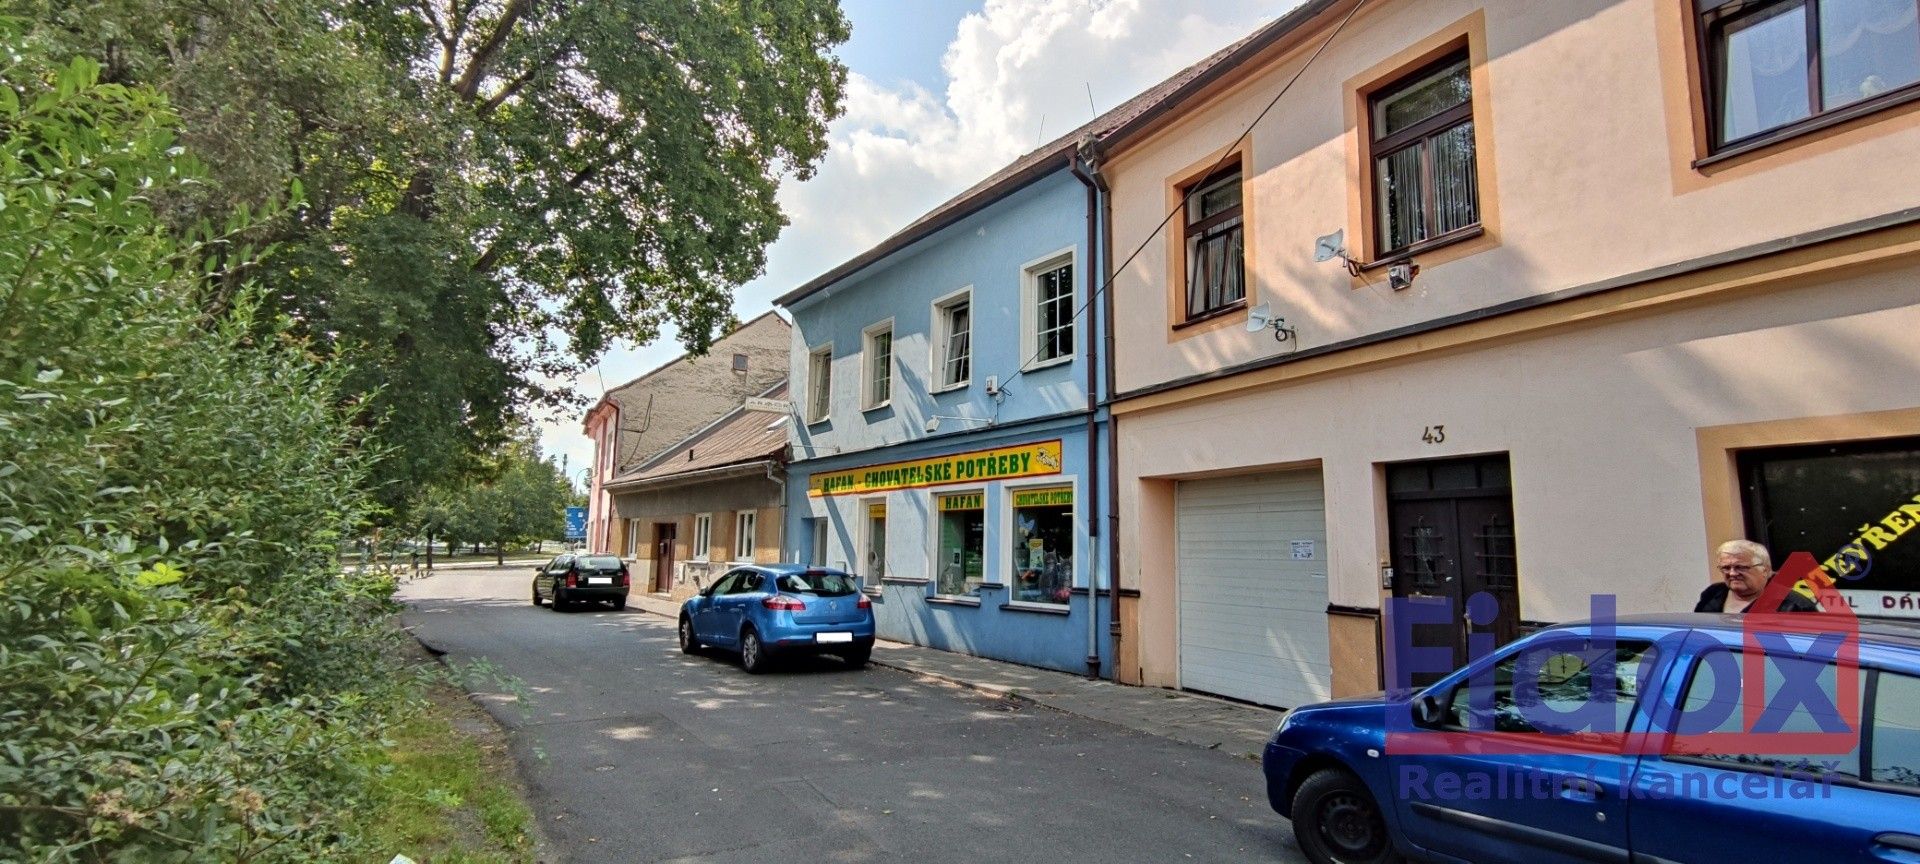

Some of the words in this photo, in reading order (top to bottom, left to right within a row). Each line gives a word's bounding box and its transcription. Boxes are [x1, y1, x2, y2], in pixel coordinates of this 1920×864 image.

[1422, 425, 1445, 444] 43
[823, 474, 854, 492] HAFAN
[864, 458, 952, 488] CHOVATELSKÉ
[956, 452, 1031, 479] POTŘEBY
[945, 494, 980, 509] HAFAN
